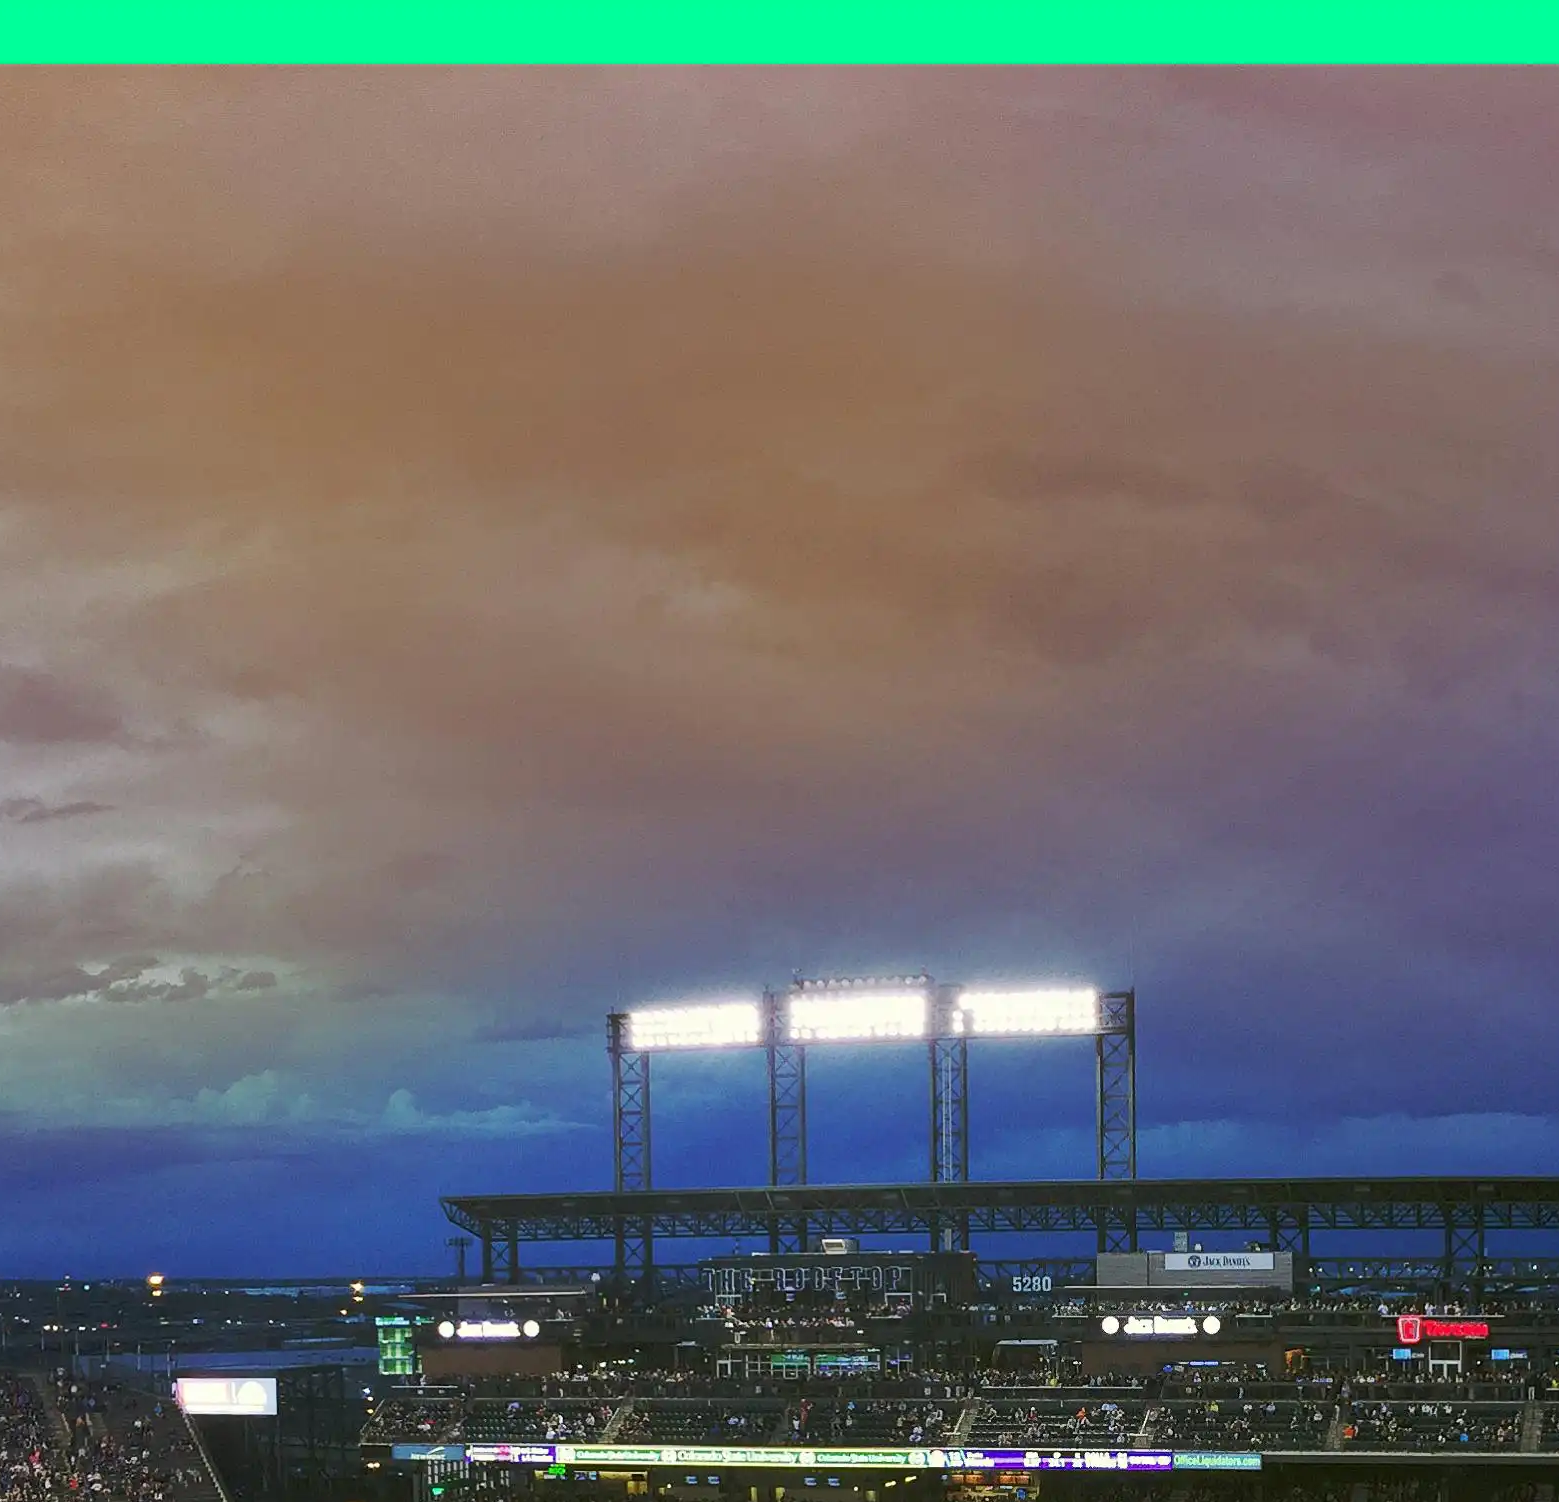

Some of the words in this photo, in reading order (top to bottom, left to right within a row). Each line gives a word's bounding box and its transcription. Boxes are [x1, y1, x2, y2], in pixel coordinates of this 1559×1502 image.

[1203, 1256, 1222, 1267] JACK
[1223, 1256, 1251, 1267] DANIEL'S
[702, 1268, 753, 1292] THE
[773, 1266, 902, 1292] ROOFTOP
[1012, 1276, 1052, 1293] 5280
[678, 1451, 722, 1462] Colorado
[722, 1451, 746, 1463] State
[747, 1452, 798, 1464] University
[1174, 1454, 1261, 1468] OfficeLiquidators.com
